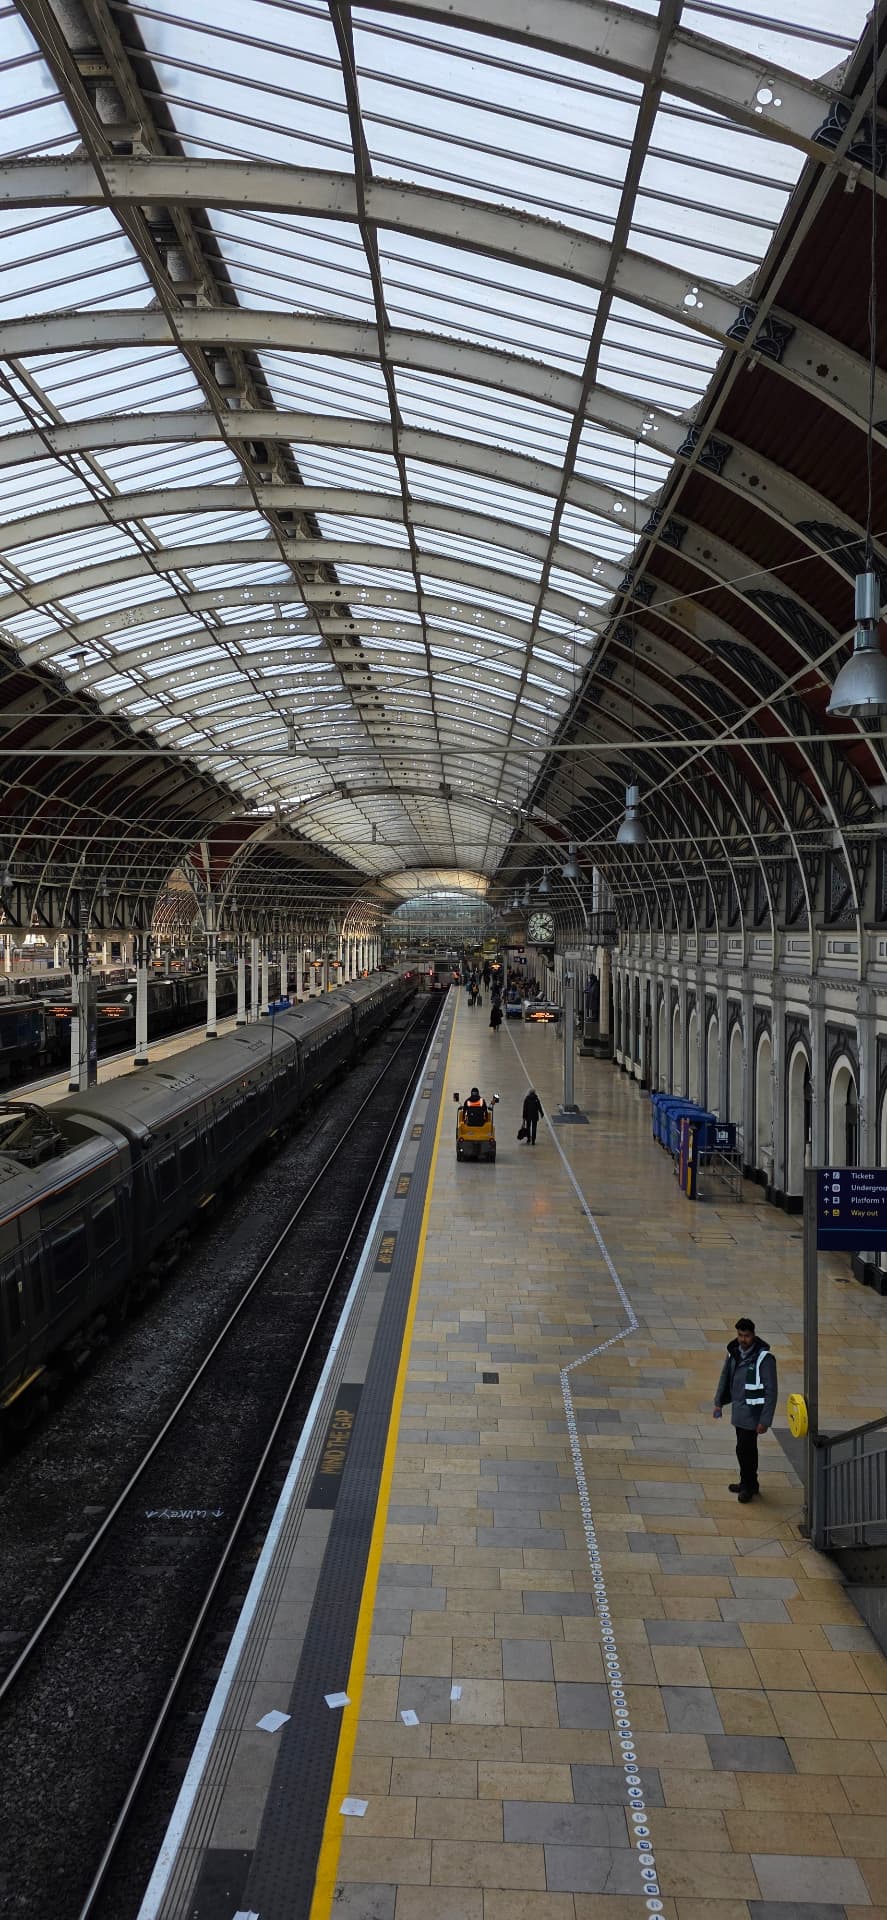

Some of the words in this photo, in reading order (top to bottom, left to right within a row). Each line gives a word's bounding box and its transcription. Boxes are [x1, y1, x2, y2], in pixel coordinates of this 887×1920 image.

[851, 1172, 875, 1180] Tickets
[851, 1196, 880, 1204] Platform
[851, 1210, 866, 1218] Way
[332, 1409, 355, 1430] GAP
[326, 1431, 351, 1447] THE
[319, 1449, 346, 1475] MIND
